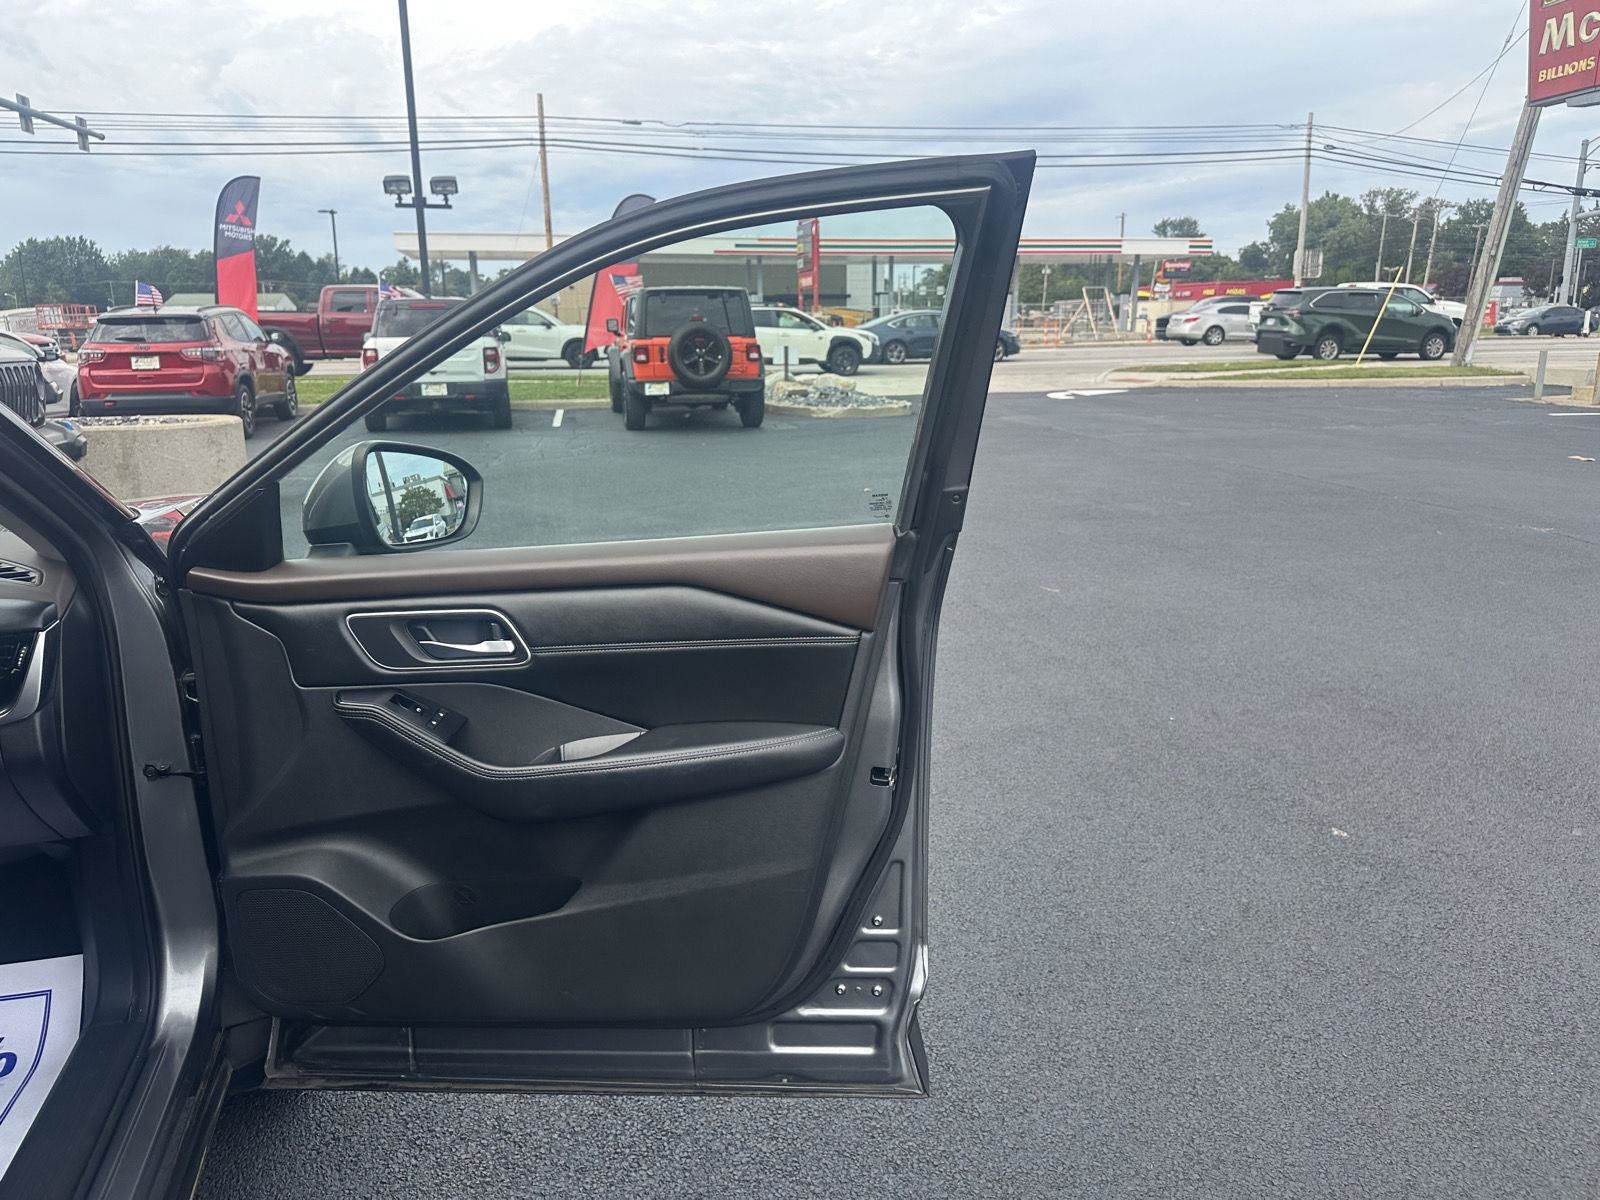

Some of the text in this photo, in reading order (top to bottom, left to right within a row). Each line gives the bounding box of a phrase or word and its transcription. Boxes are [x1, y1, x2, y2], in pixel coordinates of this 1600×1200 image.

[1537, 56, 1596, 83] BILLIONS
[220, 223, 254, 234] MITSUBISH
[224, 231, 253, 242] MOTORS
